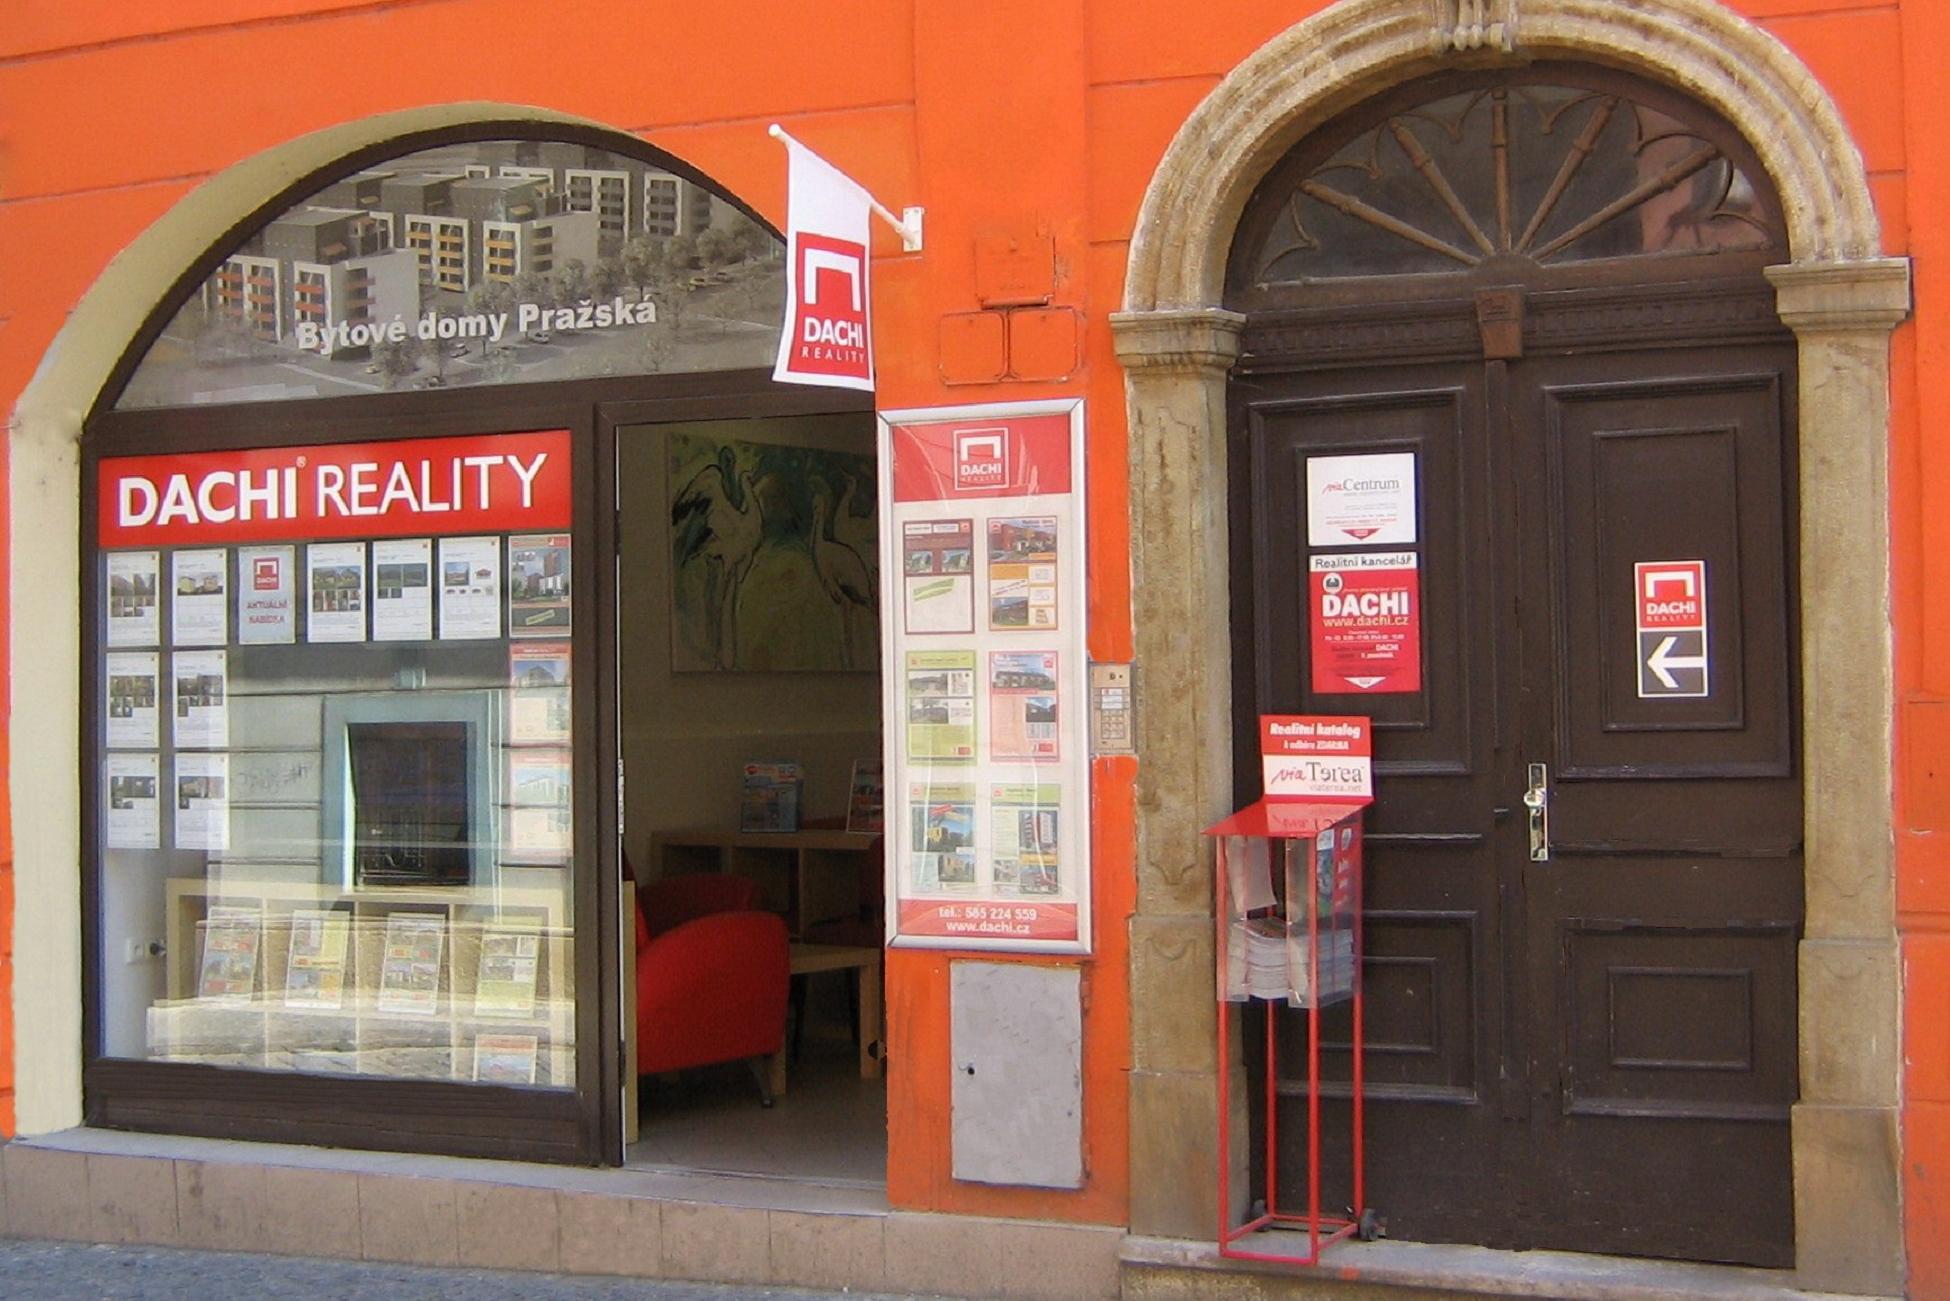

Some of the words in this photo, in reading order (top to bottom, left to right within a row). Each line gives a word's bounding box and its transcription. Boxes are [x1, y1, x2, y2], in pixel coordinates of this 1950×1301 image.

[296, 314, 406, 355] Bytové
[418, 312, 508, 342] domy
[519, 293, 656, 333] Pražská
[804, 317, 864, 348] DACHI
[802, 346, 865, 363] REALITY
[961, 463, 1001, 476] DACHI
[317, 453, 547, 517] REALITY
[1315, 556, 1359, 568] Realitní
[1361, 554, 1412, 566] kancelář
[1322, 592, 1409, 617] DACHI
[1645, 601, 1696, 615] DACHI
[1323, 615, 1409, 627] www.dachi.cz
[1646, 614, 1696, 623] REALITY
[1316, 723, 1360, 739] katalog
[990, 908, 1011, 920] 224
[946, 920, 1031, 934] www.dachi.cz
